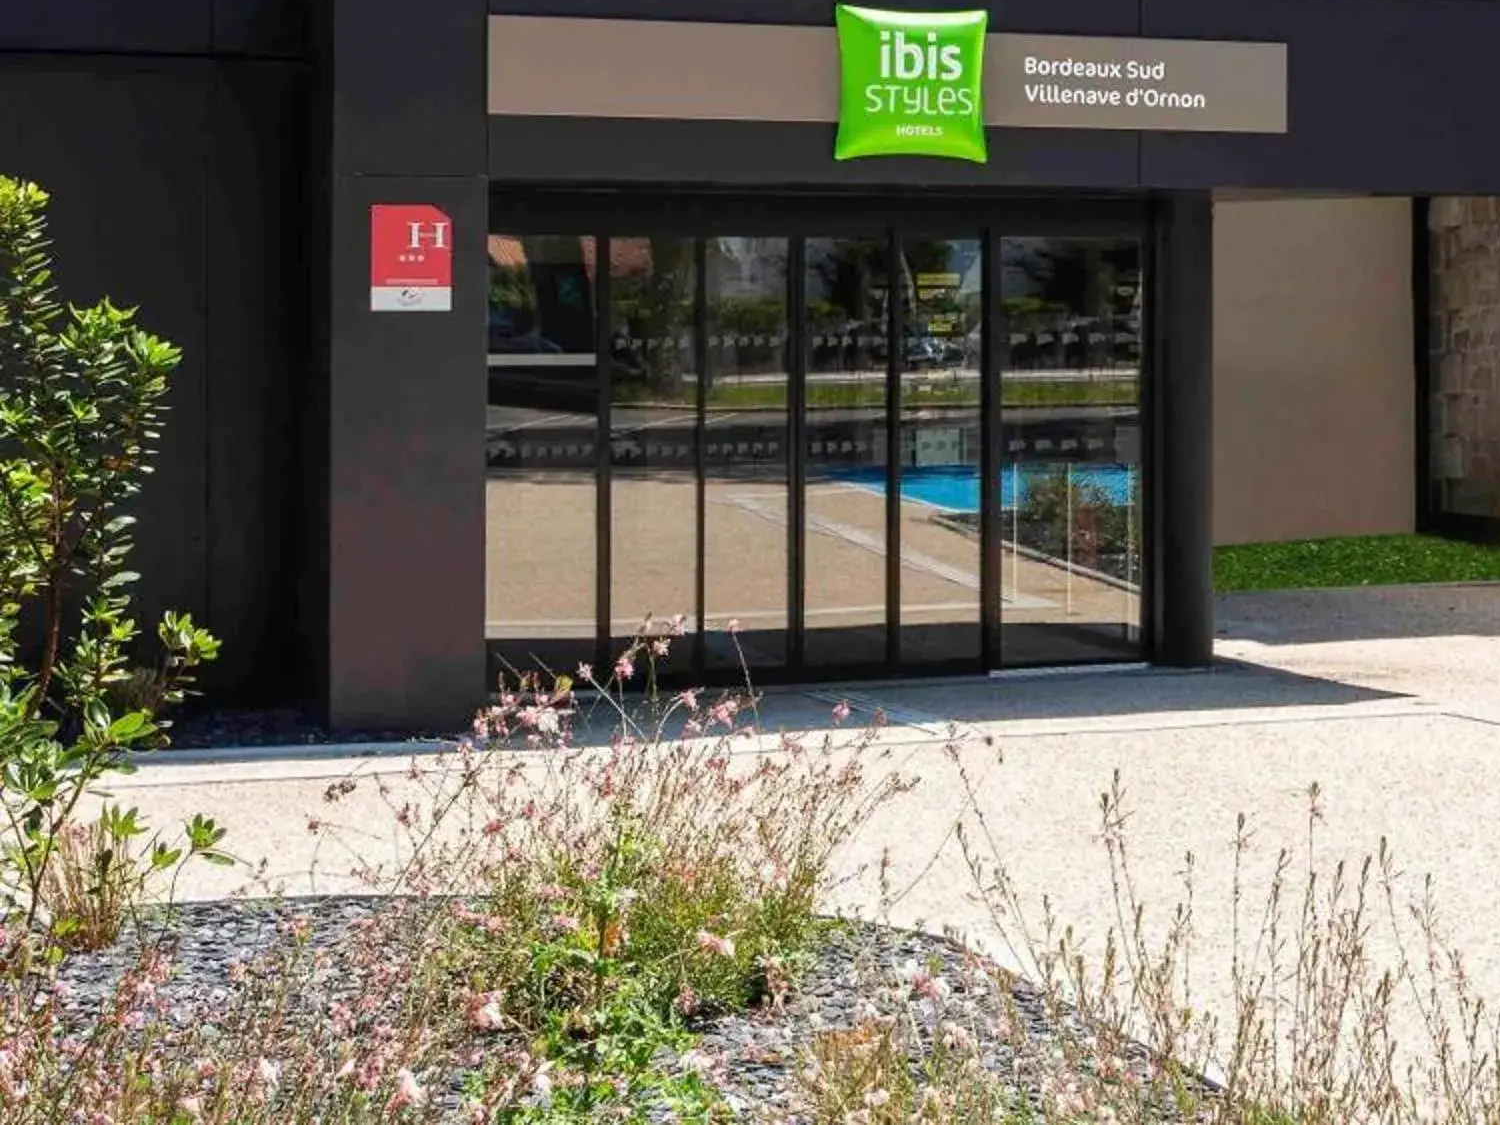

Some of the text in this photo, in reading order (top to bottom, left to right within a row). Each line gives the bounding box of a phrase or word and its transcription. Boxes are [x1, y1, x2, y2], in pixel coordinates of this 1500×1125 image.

[880, 30, 963, 81] ibis
[1024, 56, 1165, 80] Bordeaux Sud
[1024, 84, 1205, 108] Villenave d'Ornon
[896, 124, 943, 136] HOTELS
[406, 221, 449, 249] H
